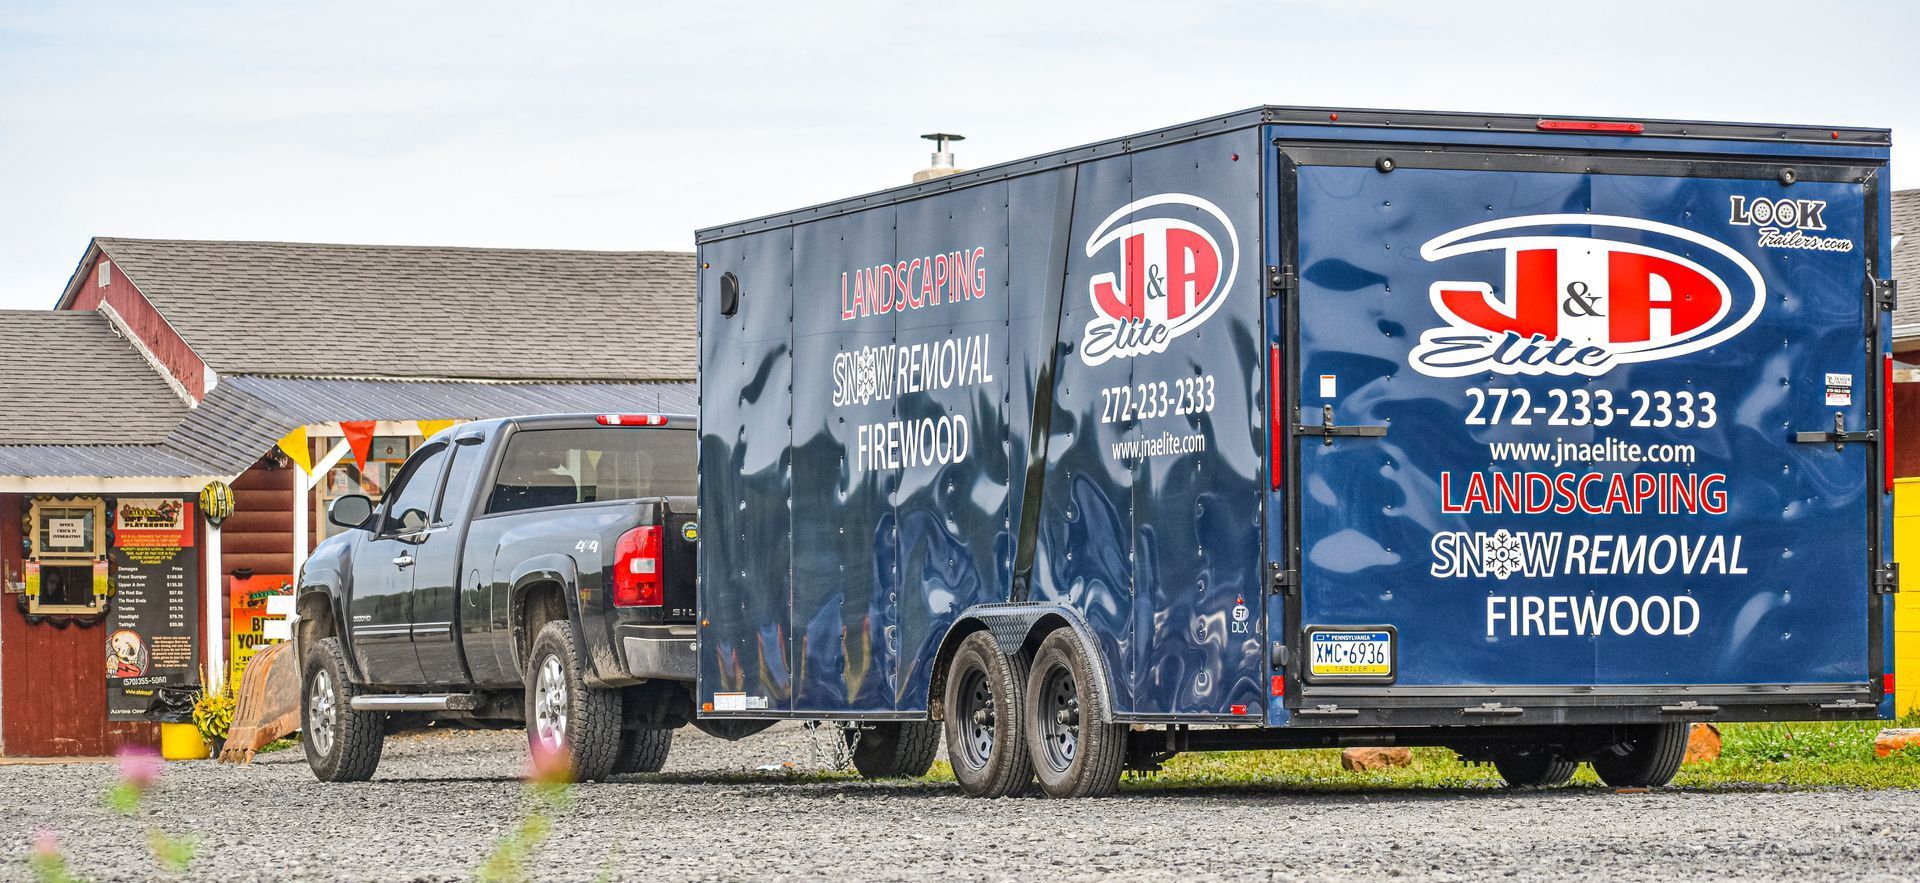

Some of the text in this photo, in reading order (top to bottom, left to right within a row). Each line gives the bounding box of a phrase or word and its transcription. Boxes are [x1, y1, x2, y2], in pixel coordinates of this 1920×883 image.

[1730, 195, 1826, 230] LOOK
[841, 246, 986, 320] LANDSCAPING
[1084, 316, 1170, 358] Elite
[1419, 330, 1613, 367] Elite
[896, 333, 993, 395] REMOVAL
[1101, 374, 1216, 424] 272-233-2333
[1464, 387, 1718, 429] 272-233-2333
[858, 414, 969, 472] FIREWOOD
[1112, 431, 1206, 463] www.jnaelite.com
[1489, 437, 1696, 468] www.jnaelite.com
[1440, 472, 1728, 515] LANDSCAPING
[1563, 534, 1749, 576] REMOVAL
[1231, 621, 1249, 634] DLX
[1486, 596, 1701, 636] FIREWOOD
